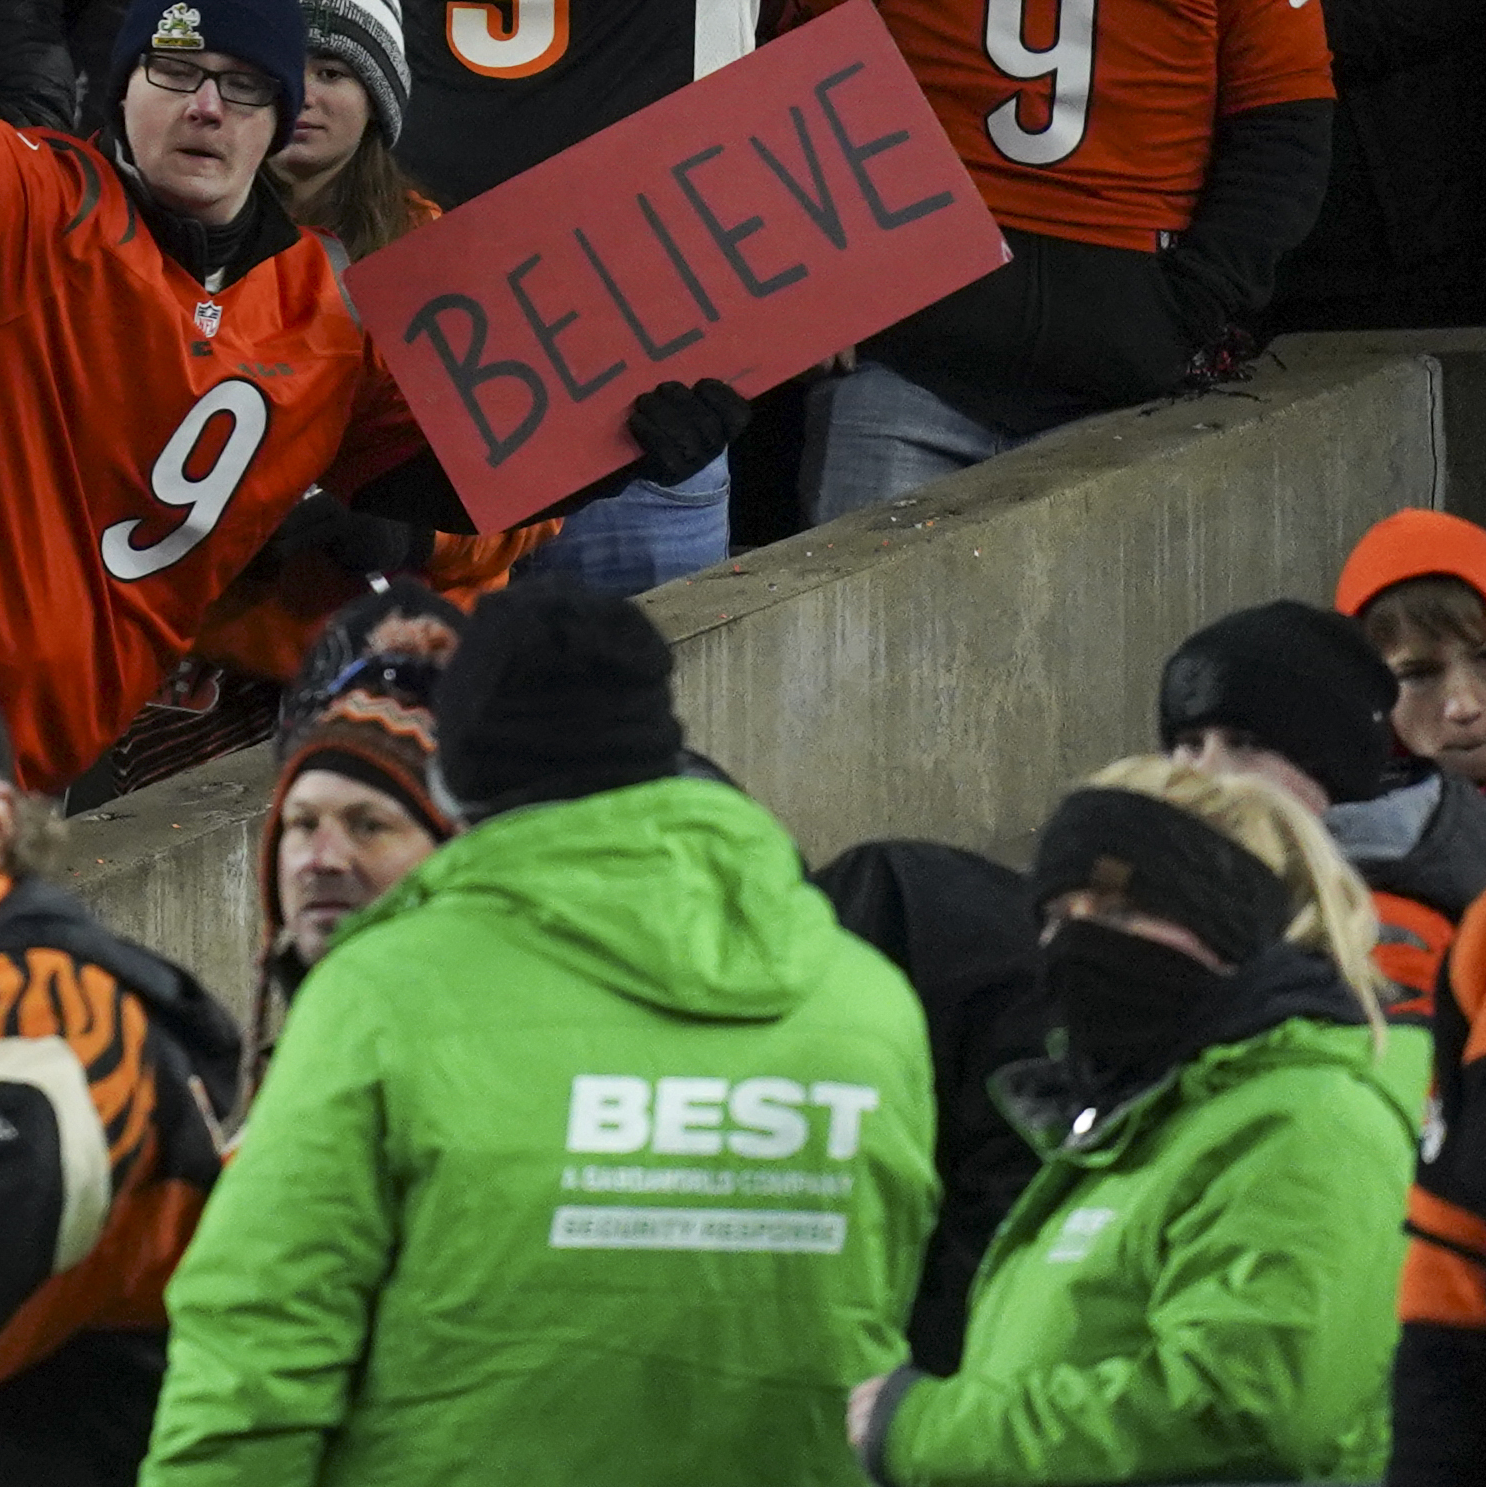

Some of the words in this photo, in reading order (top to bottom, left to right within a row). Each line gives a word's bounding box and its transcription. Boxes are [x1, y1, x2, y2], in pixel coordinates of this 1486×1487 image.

[405, 61, 955, 471] BELIEVE
[100, 379, 269, 581] 9
[565, 1073, 880, 1161] BEST
